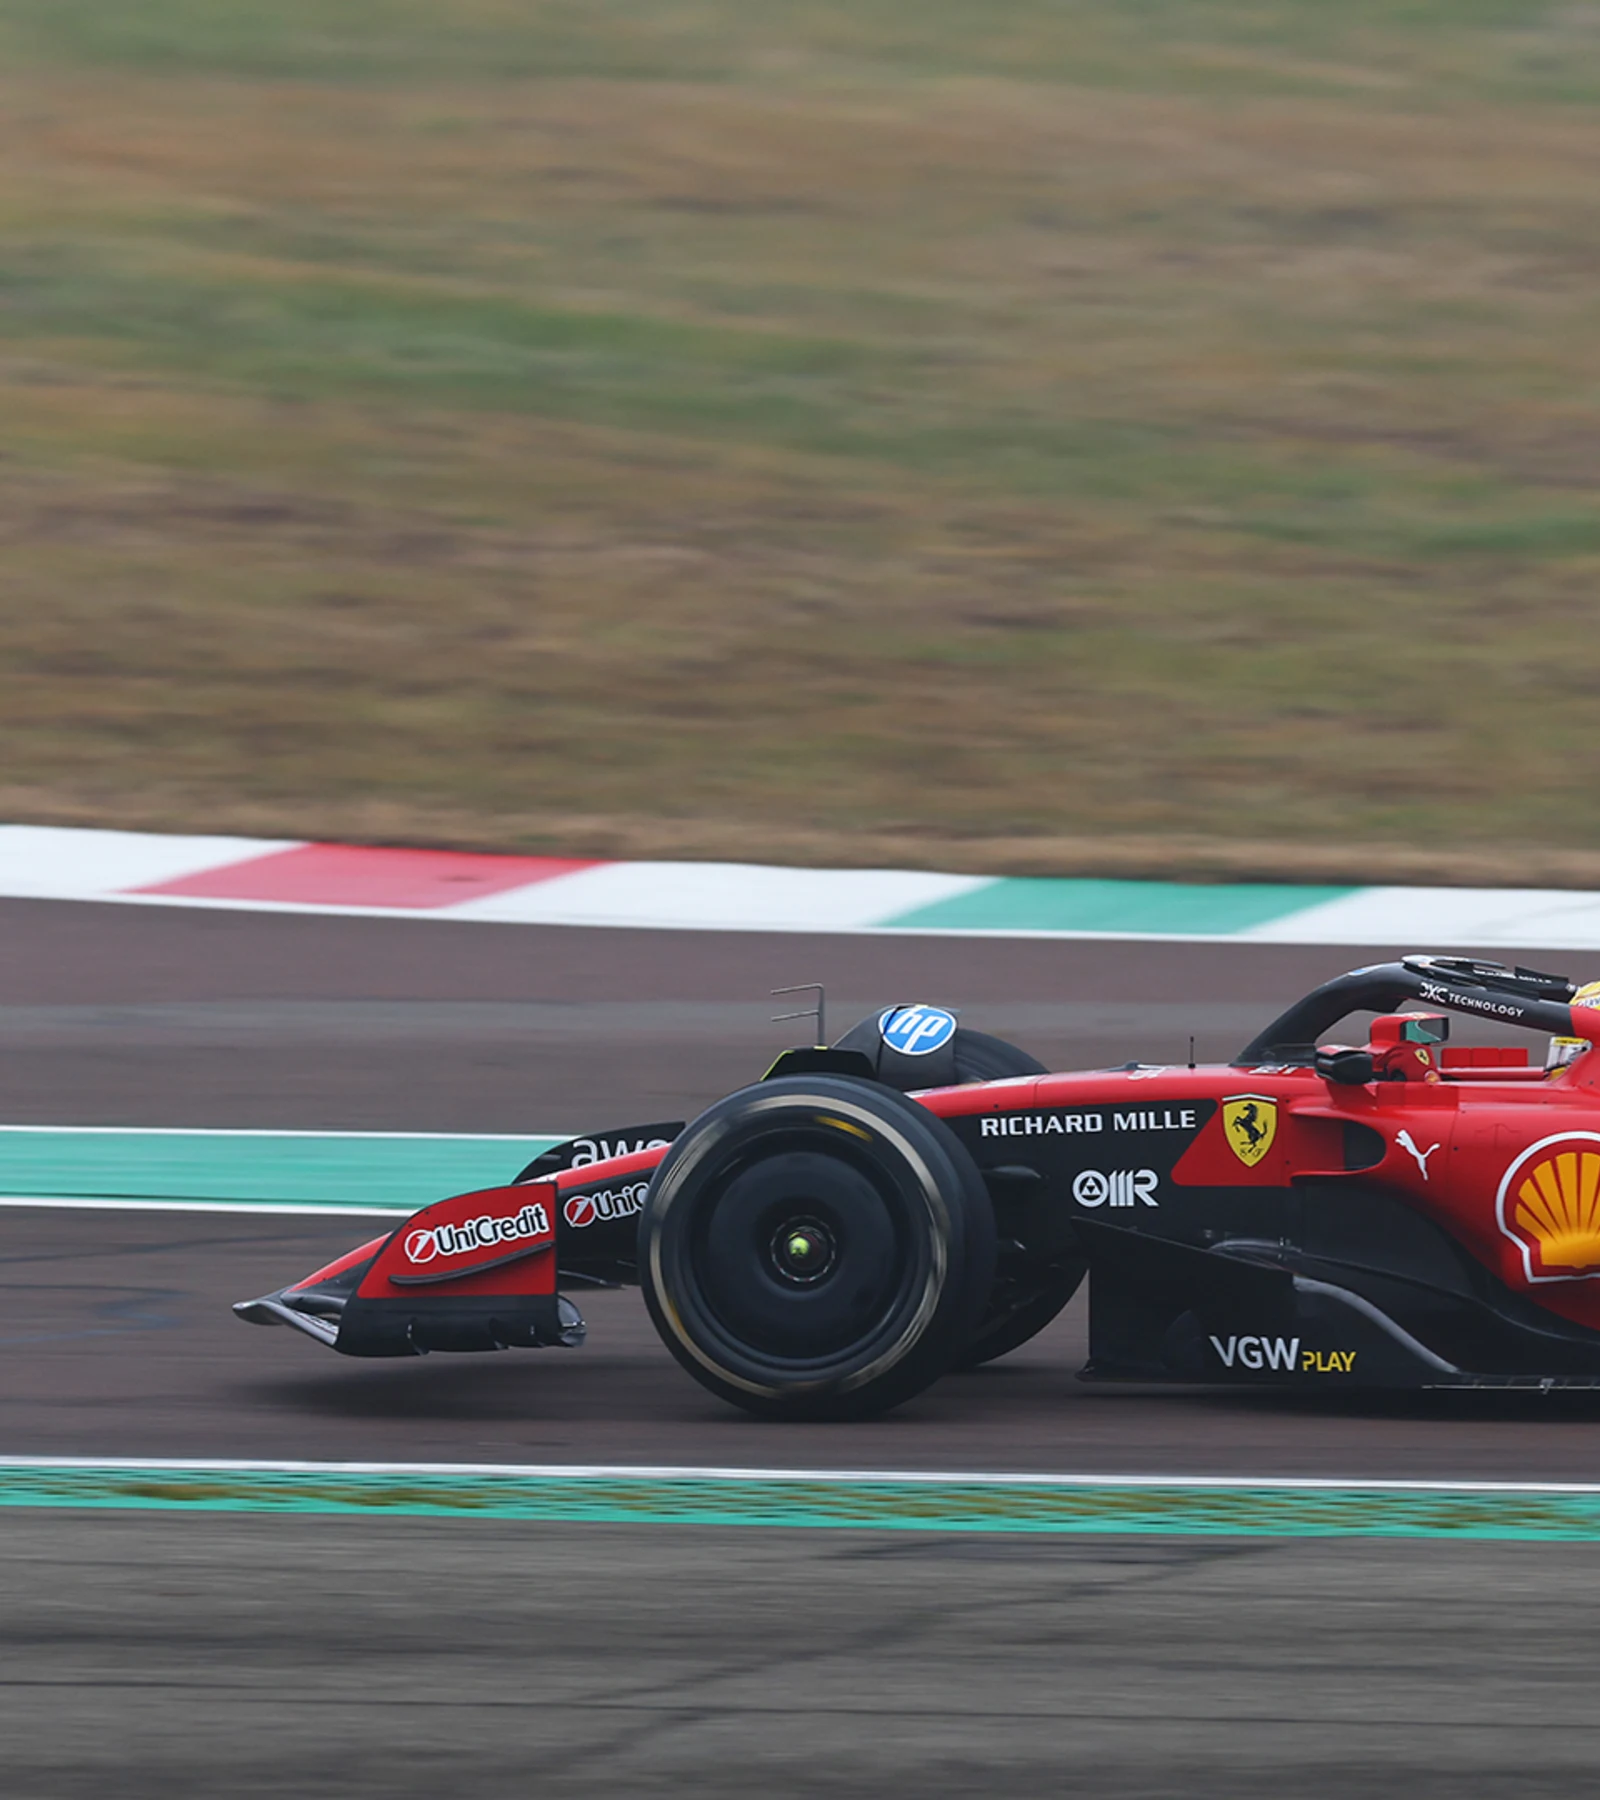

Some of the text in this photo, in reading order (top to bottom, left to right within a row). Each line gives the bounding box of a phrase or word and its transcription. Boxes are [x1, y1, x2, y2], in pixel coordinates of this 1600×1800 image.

[1449, 994, 1525, 1018] TECHNOLOGY
[888, 1006, 950, 1052] hp
[980, 1109, 1197, 1137] RICHARD MILLE
[433, 1205, 549, 1255] UniCredit
[1208, 1335, 1357, 1372] VGW PLAY
